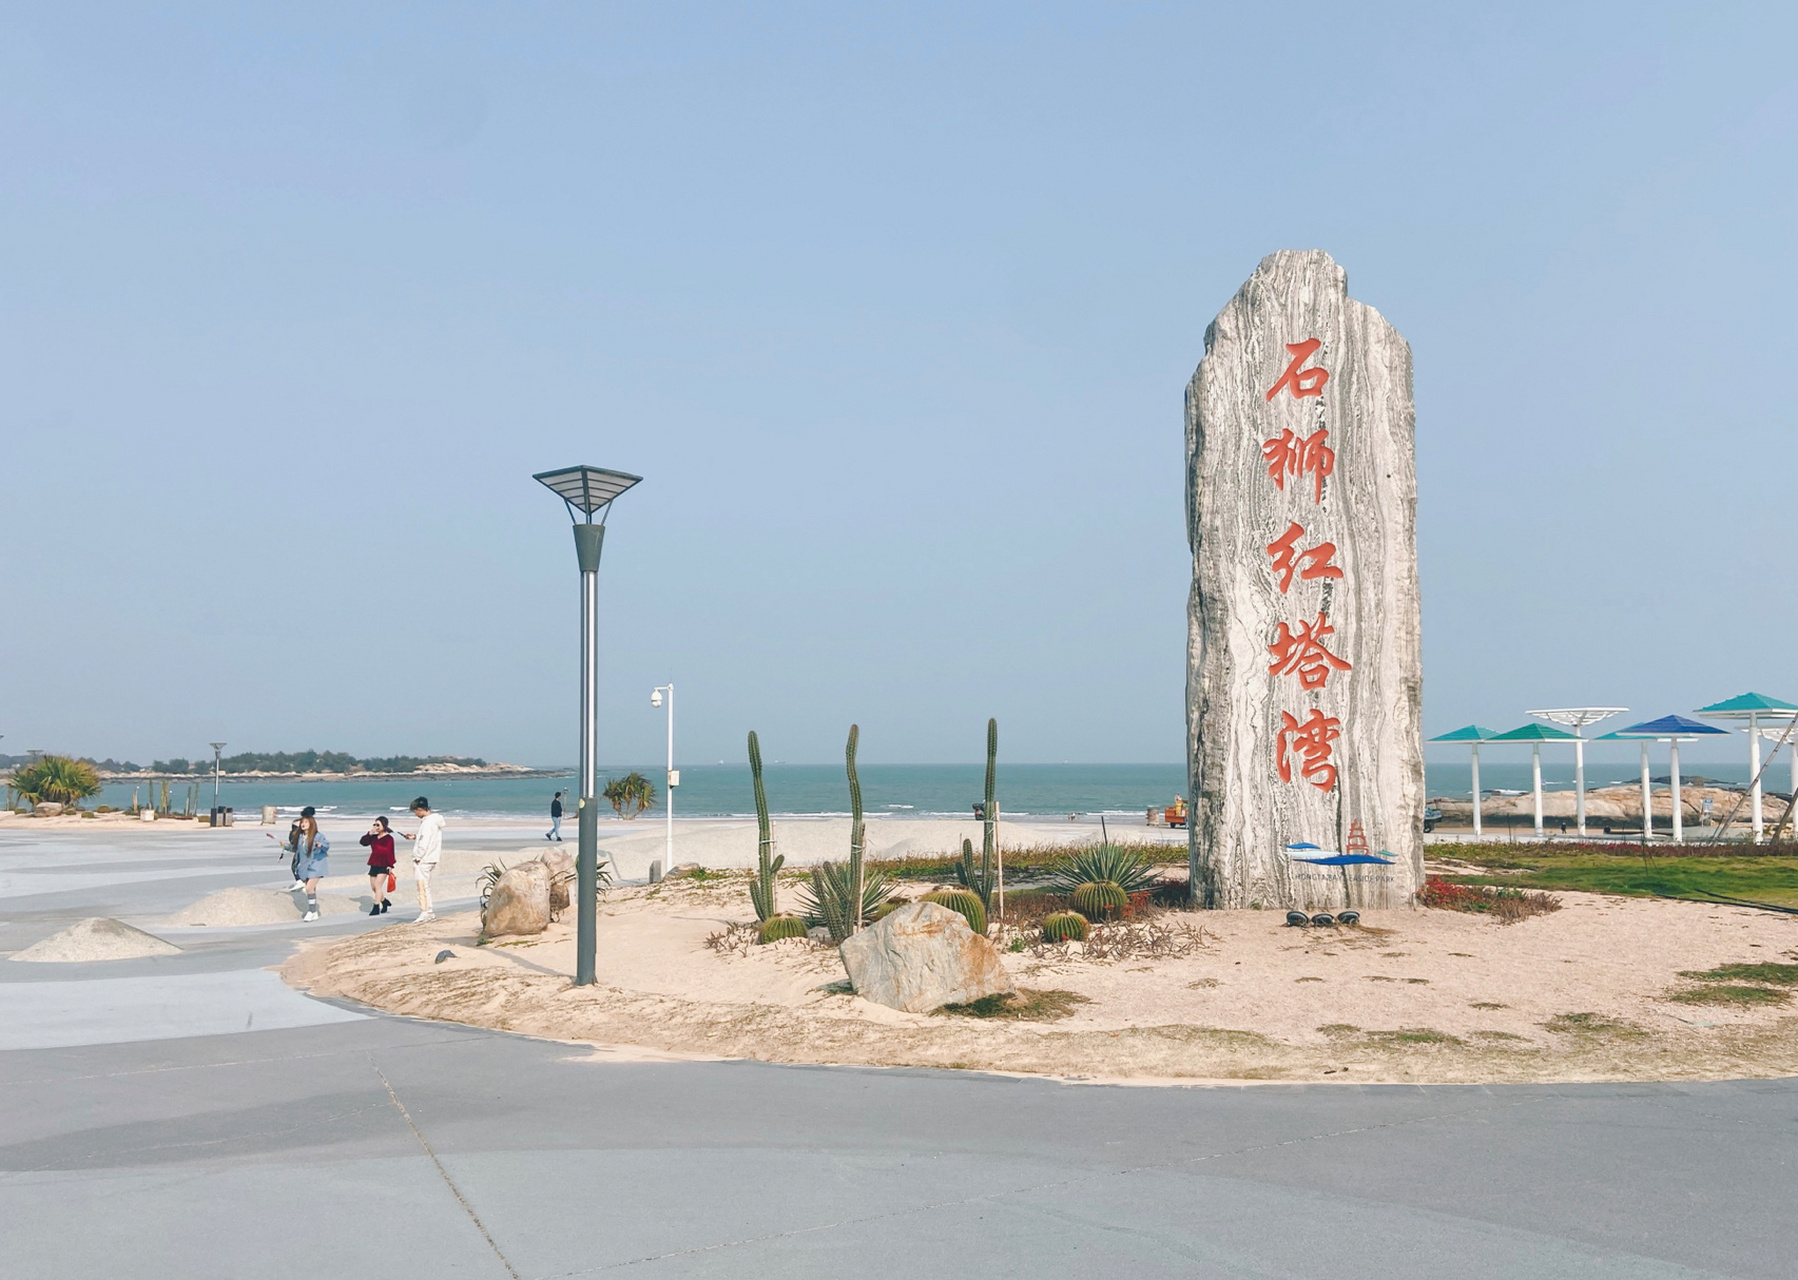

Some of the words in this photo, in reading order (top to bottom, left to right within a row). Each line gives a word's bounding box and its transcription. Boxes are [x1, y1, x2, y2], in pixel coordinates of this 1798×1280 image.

[1262, 337, 1351, 793] 石狮红塔湾
[1295, 873, 1326, 881] HONGTA
[1327, 873, 1342, 881] BAY
[1343, 874, 1374, 882] EASIDE
[1376, 874, 1395, 882] PARK
